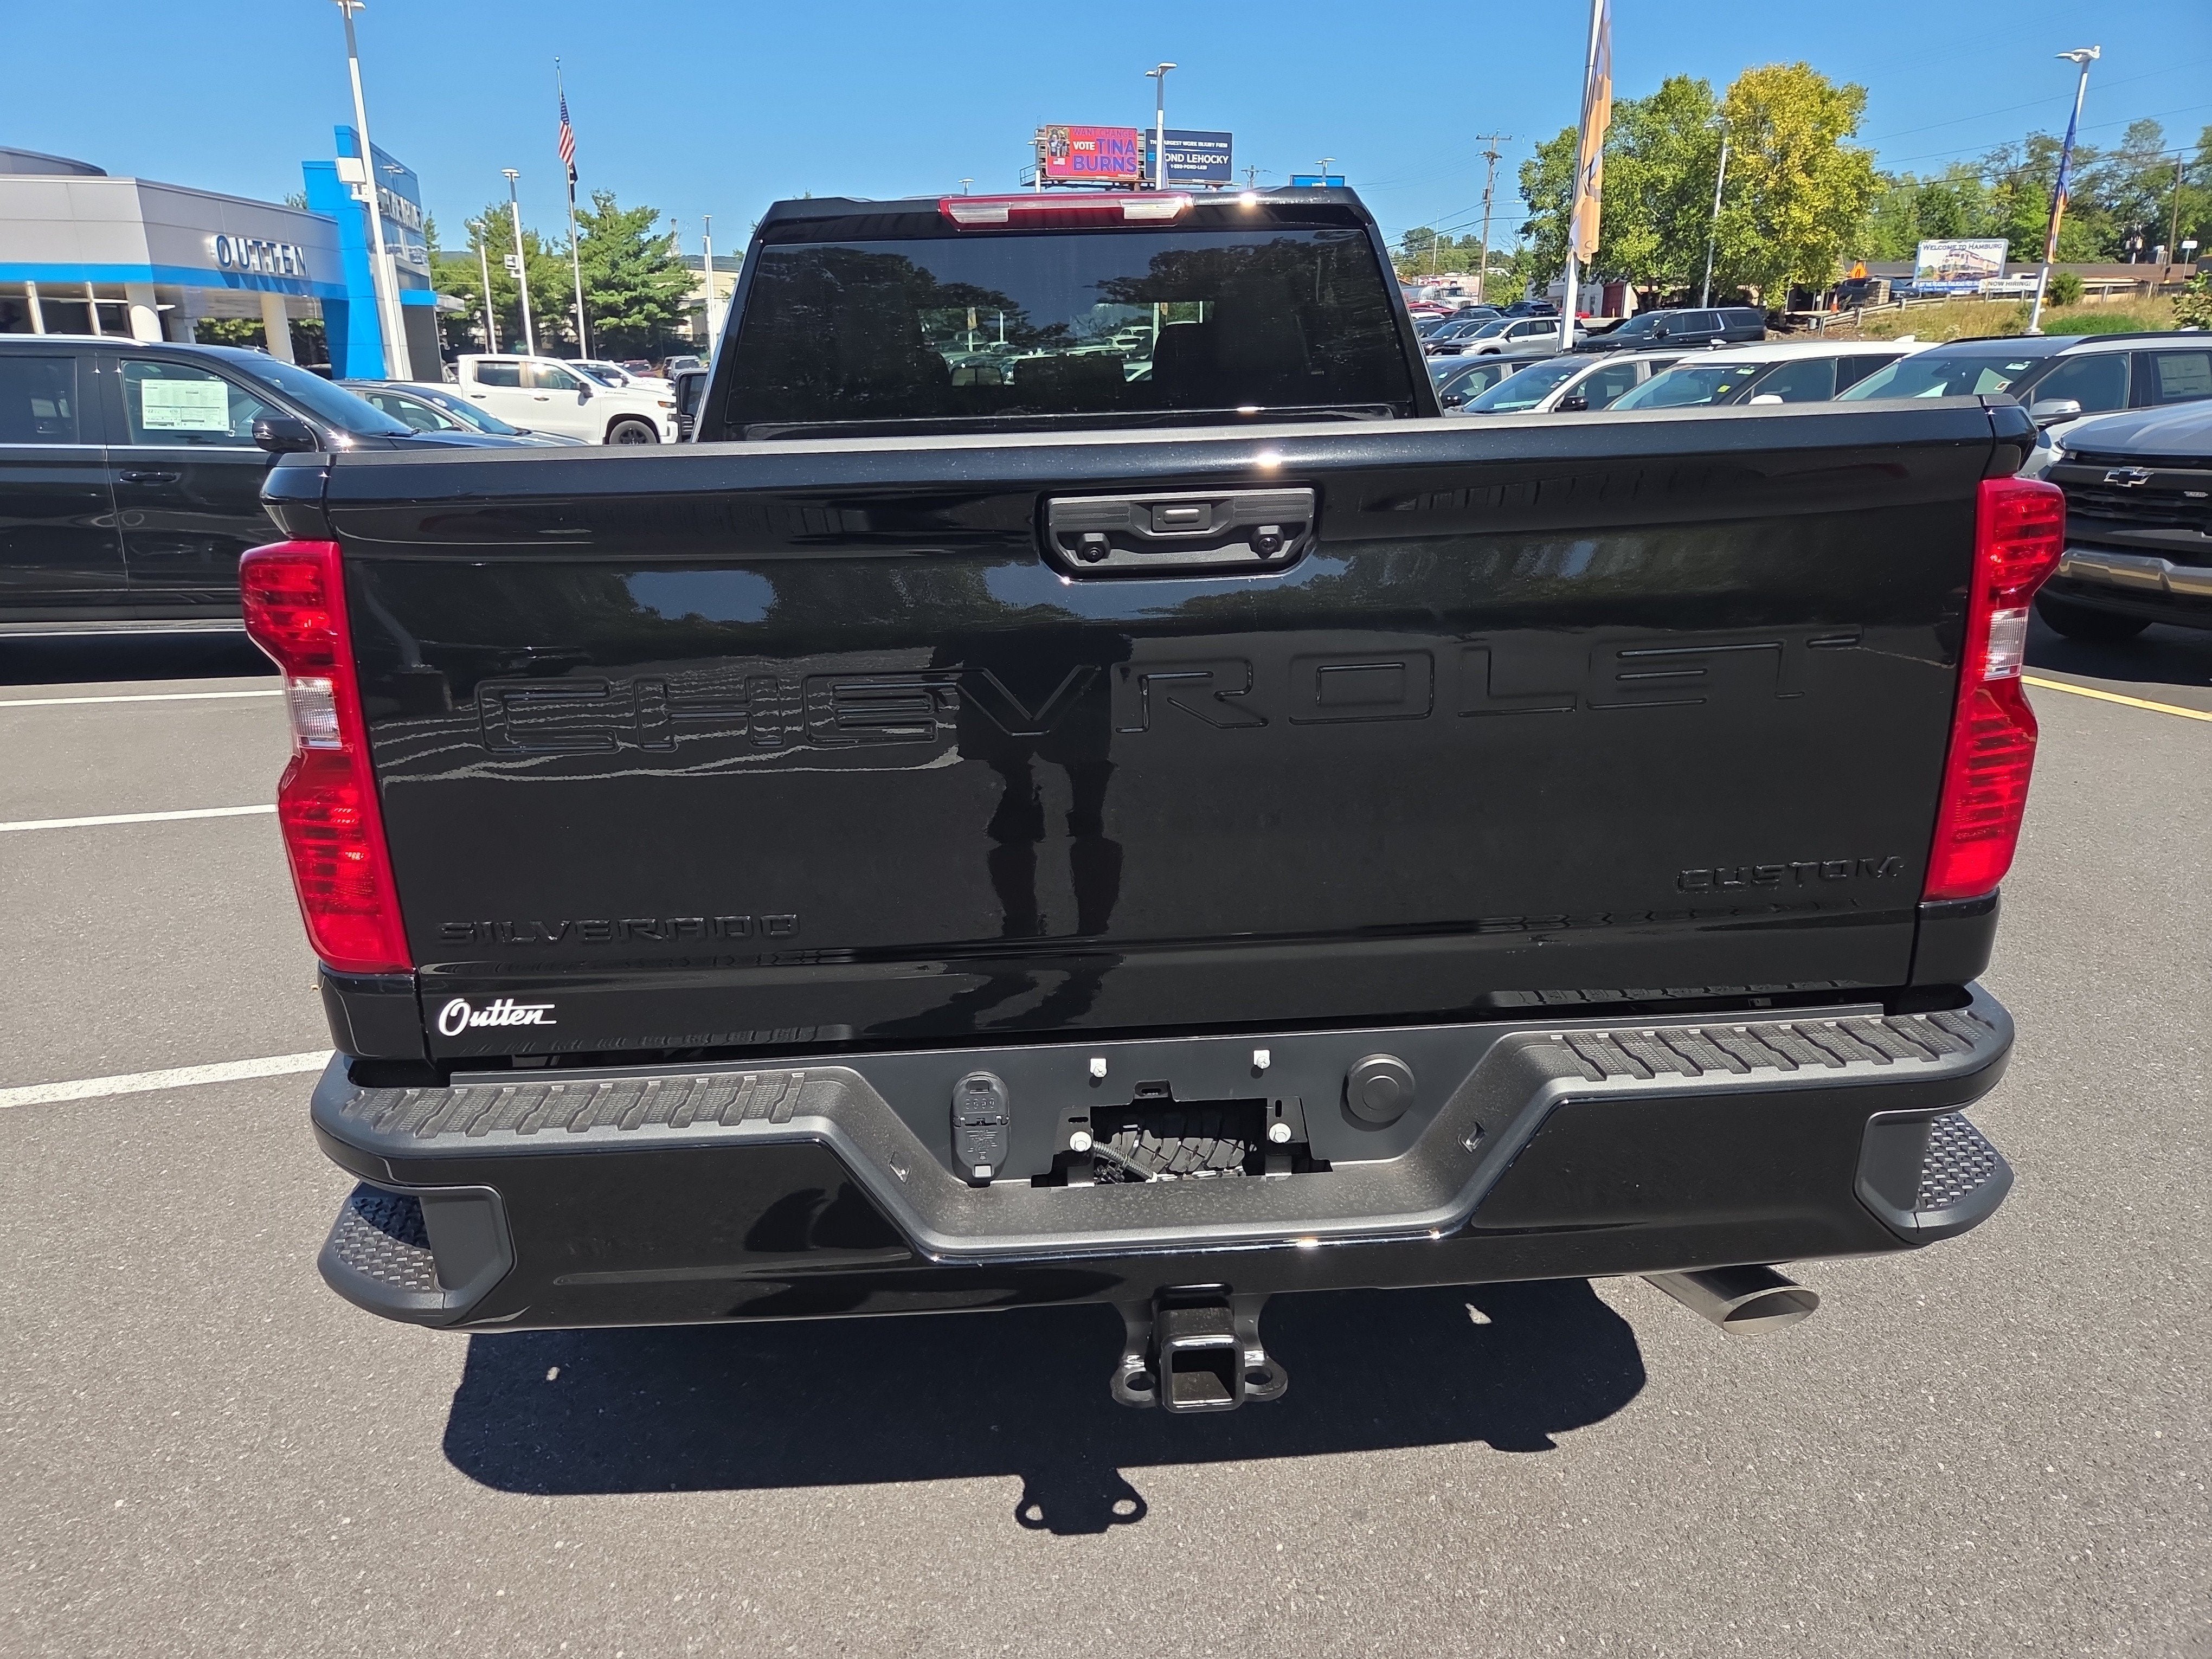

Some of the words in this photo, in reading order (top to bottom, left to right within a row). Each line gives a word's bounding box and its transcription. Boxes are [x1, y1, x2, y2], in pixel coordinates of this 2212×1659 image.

[1073, 128, 1097, 136] WANT
[1099, 129, 1137, 138] CHANGE?
[1073, 141, 1096, 151] VOTE
[1096, 138, 1136, 156] TINA
[1073, 154, 1137, 173] BURNS
[1165, 153, 1184, 162] OND
[1187, 153, 1229, 164] LEHOCKY
[210, 235, 308, 276] OUTTEN
[475, 623, 1863, 754] CHEVROLET
[1678, 854, 1904, 892] CUSTOM
[439, 914, 802, 945] SILVERADO
[438, 998, 557, 1036] Outten
